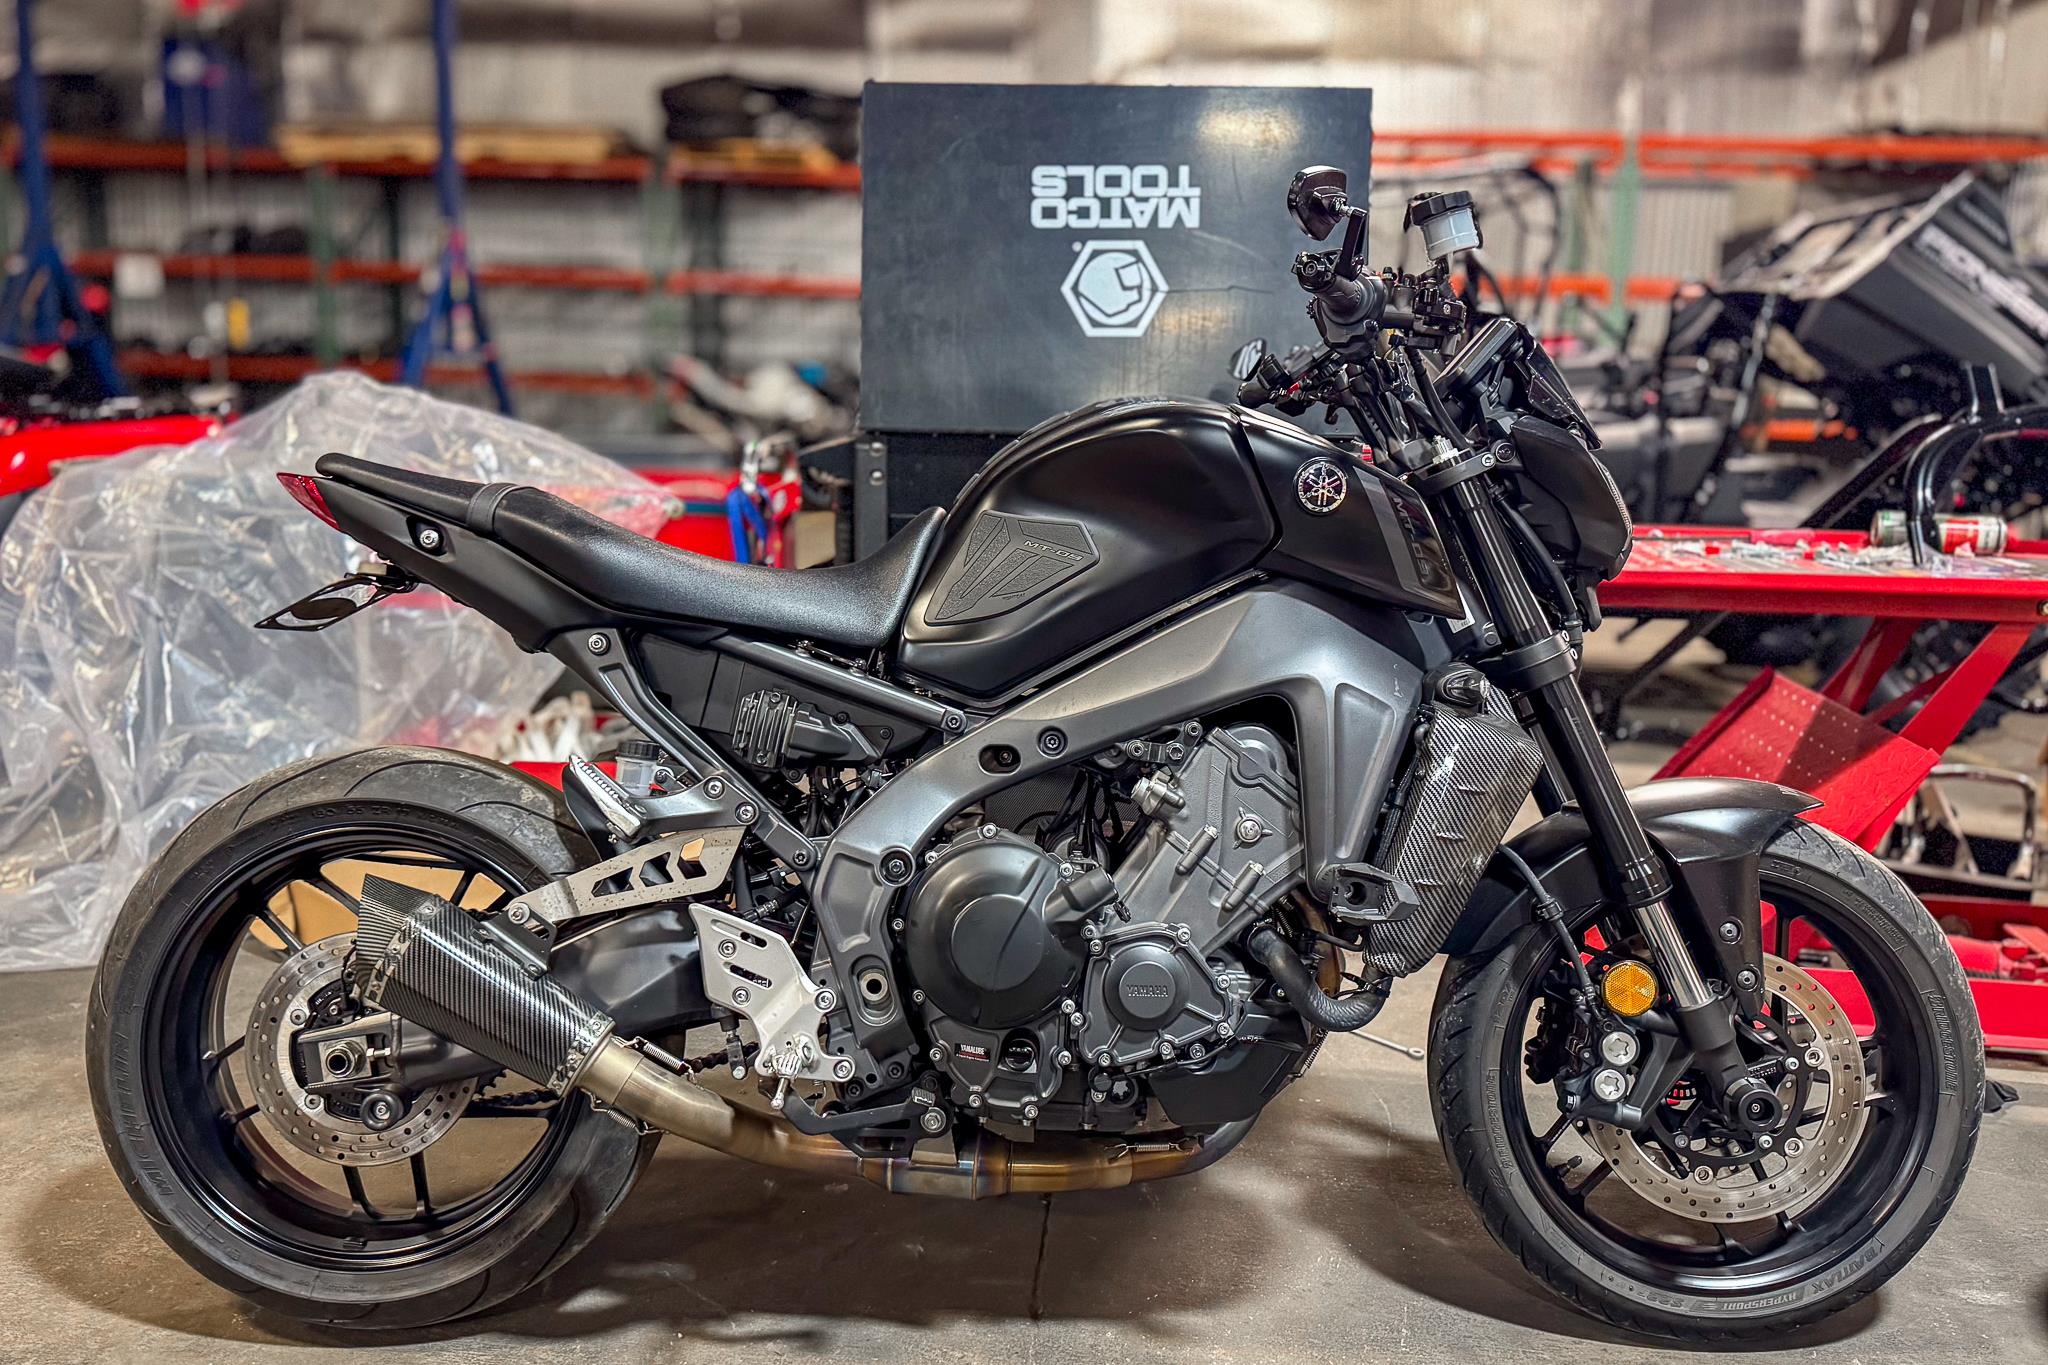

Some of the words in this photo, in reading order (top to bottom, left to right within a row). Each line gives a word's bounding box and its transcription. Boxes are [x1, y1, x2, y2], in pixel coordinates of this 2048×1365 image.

[1031, 165, 1201, 198] TOOLS
[1031, 197, 1201, 229] MATCO
[1393, 497, 1430, 577] MT-09
[1024, 540, 1085, 561] MT-09
[1126, 984, 1169, 998] YAMAHA
[1722, 1293, 1797, 1312] HYPERSPORT
